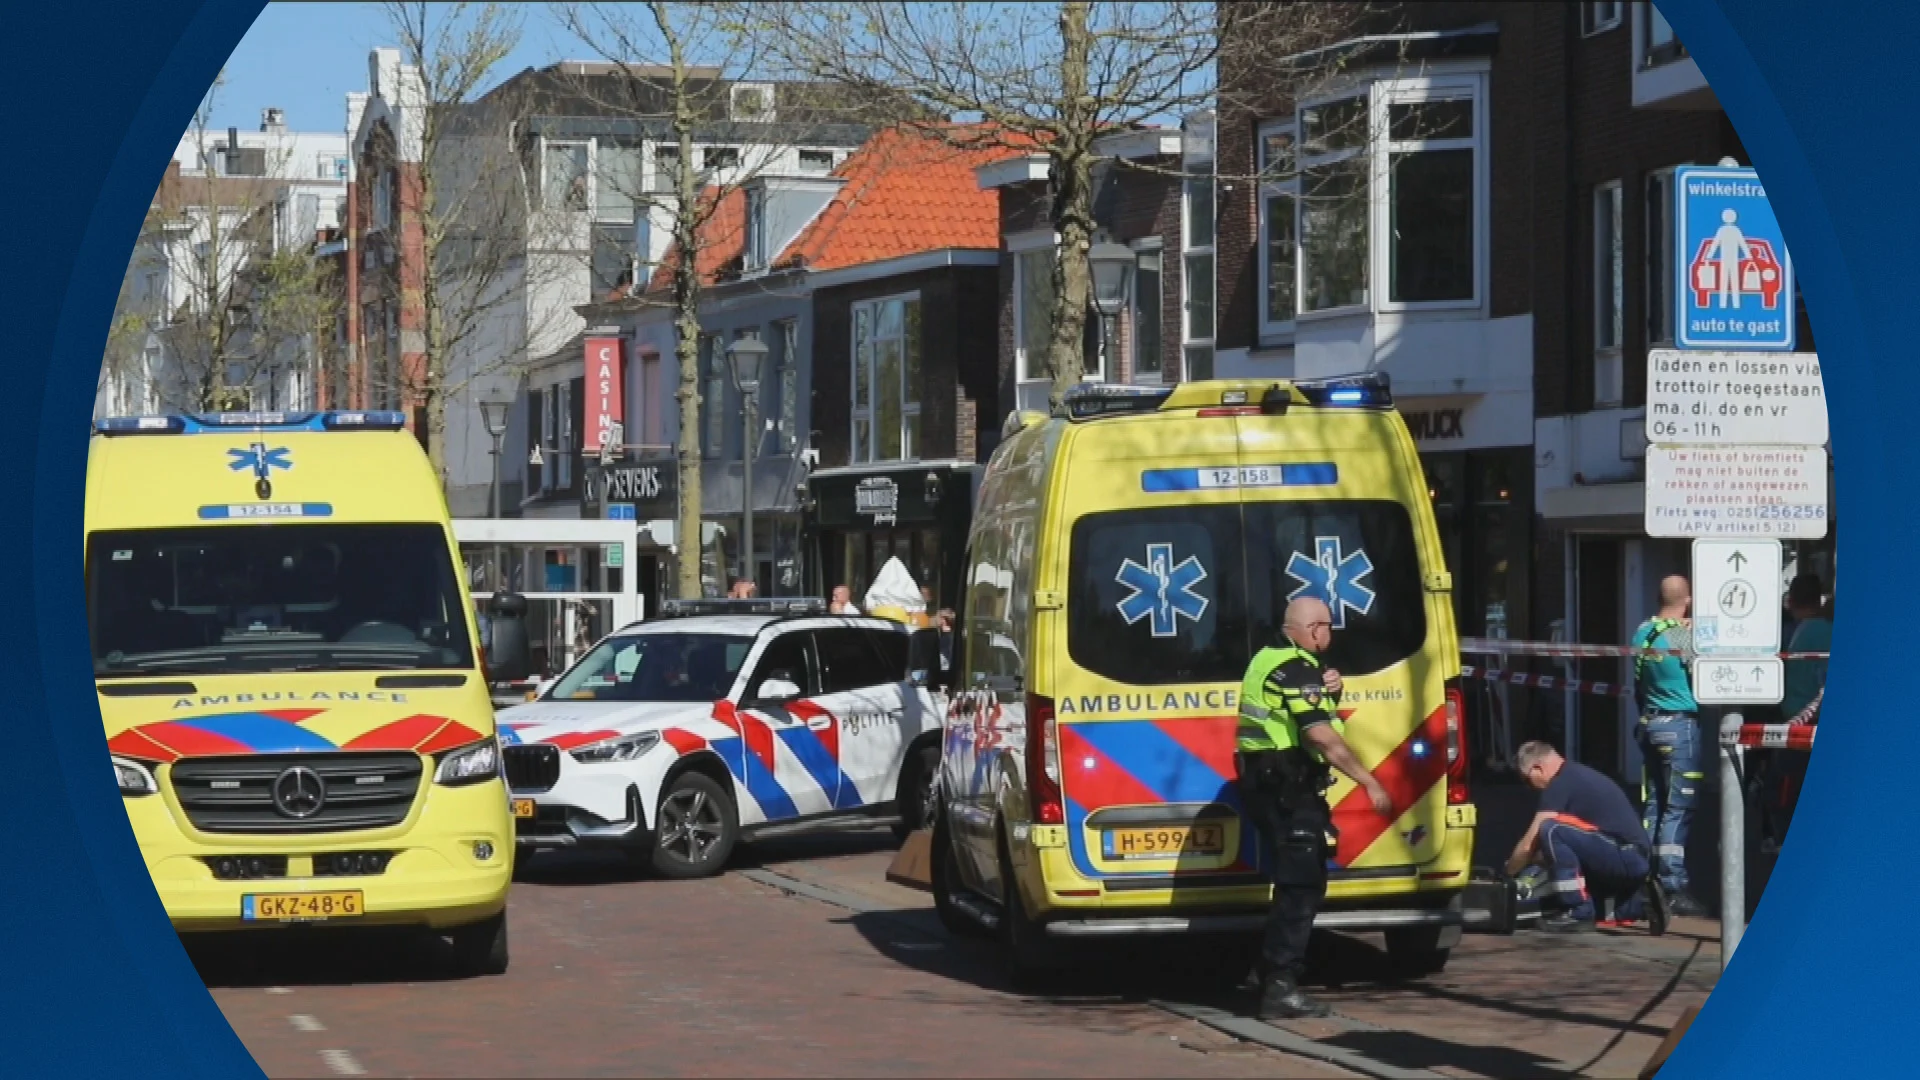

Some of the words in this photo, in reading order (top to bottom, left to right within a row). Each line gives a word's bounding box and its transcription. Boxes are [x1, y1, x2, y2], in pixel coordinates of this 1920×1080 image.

[1692, 319, 1725, 332] auto
[1729, 319, 1744, 332] te
[1748, 319, 1780, 335] gast
[1655, 358, 1701, 372] laden
[1709, 361, 1728, 372] en
[1736, 360, 1788, 374] lossen
[1796, 362, 1820, 375] via
[598, 348, 611, 445] CASINO
[1656, 380, 1720, 393] trottoir
[1727, 381, 1820, 398] toegestaan
[1719, 402, 1738, 416] do
[1744, 404, 1763, 416] en
[1771, 405, 1788, 416] vr
[1654, 421, 1677, 435] 06
[1711, 422, 1721, 436] h
[1692, 452, 1721, 462] fiets
[1726, 452, 1738, 462] of
[1743, 452, 1805, 463] bromfiets
[1212, 469, 1269, 483] 12-158
[1675, 467, 1702, 477] mag
[1707, 466, 1732, 476] niet
[1737, 466, 1779, 477] buiten
[1784, 467, 1799, 477] de
[614, 467, 660, 499] SEVENS
[1665, 480, 1709, 490] rekken
[1713, 480, 1726, 490] of
[1730, 482, 1809, 492] aangewezen
[1686, 495, 1743, 505] plaatsen
[220, 505, 293, 515] 12-154
[1656, 505, 1688, 517] Fiets
[1716, 521, 1761, 533] artikel
[172, 691, 409, 709] AMBULANCE
[1059, 689, 1238, 715] AMBULANCE
[1339, 691, 1361, 703] te
[1364, 686, 1403, 700] kruis
[260, 895, 355, 916] GKZ-48-G
